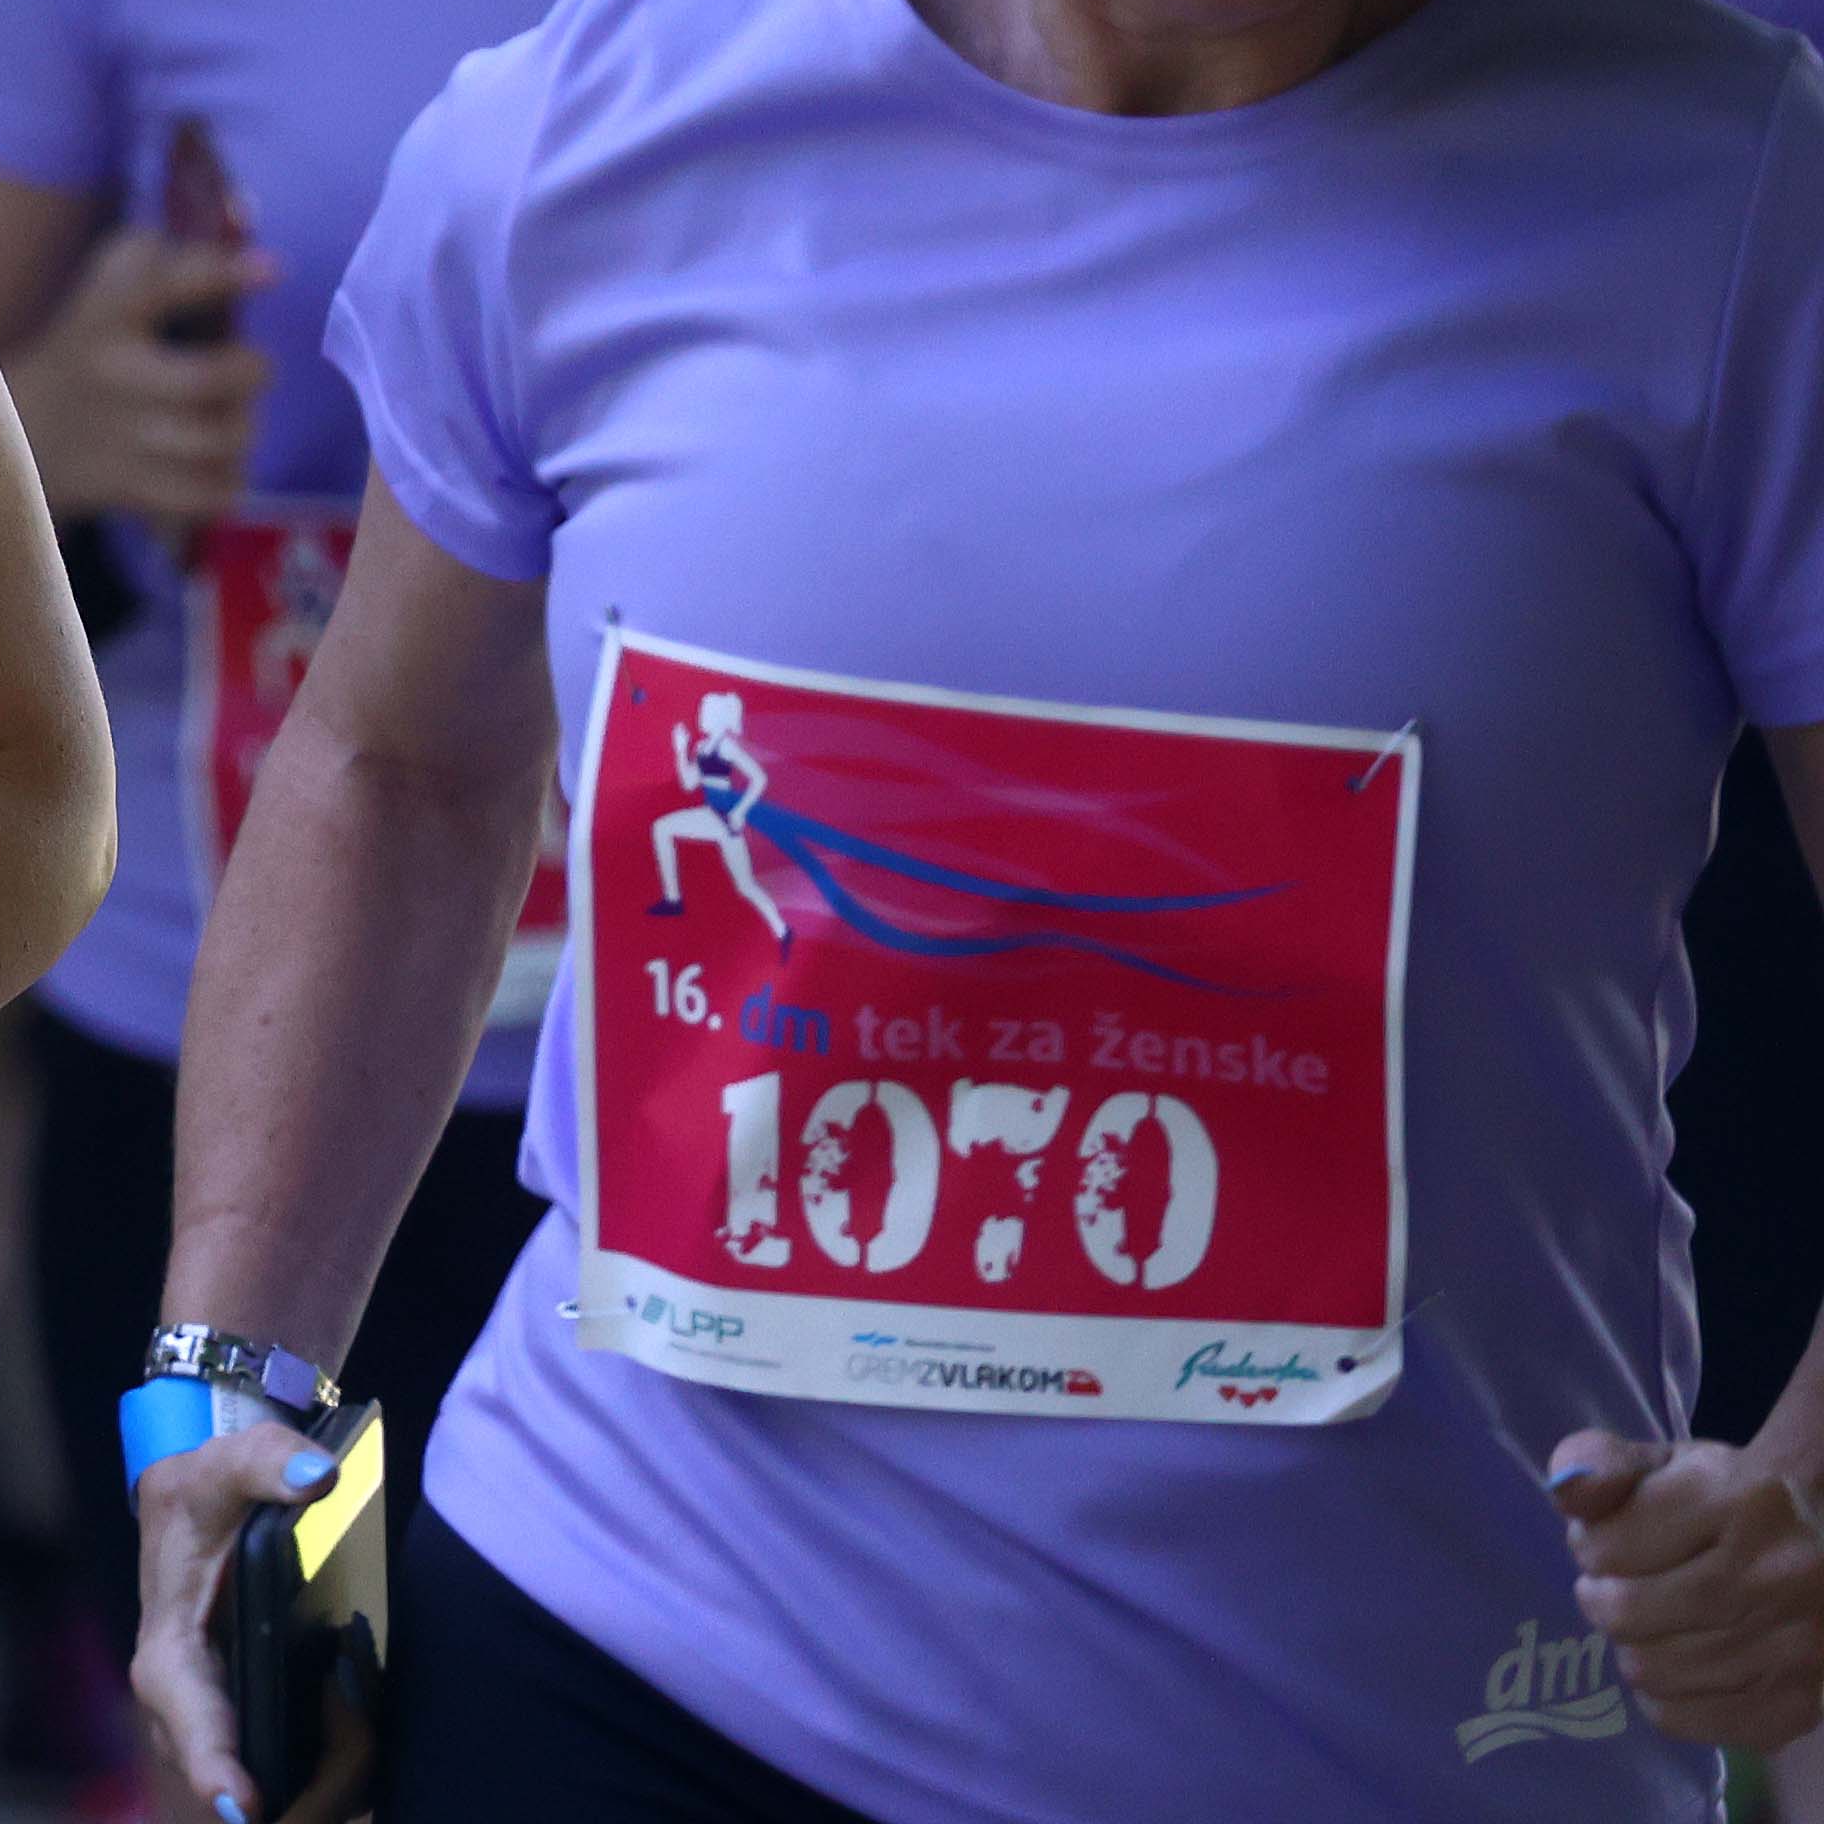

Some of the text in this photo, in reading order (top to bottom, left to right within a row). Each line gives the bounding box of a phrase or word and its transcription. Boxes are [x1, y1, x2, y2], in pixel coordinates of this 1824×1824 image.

[644, 957, 1329, 1094] 16. dm tek za ženske
[714, 1072, 1218, 1290] 1070
[668, 1297, 745, 1344] LPP
[1484, 1618, 1608, 1711] dm
